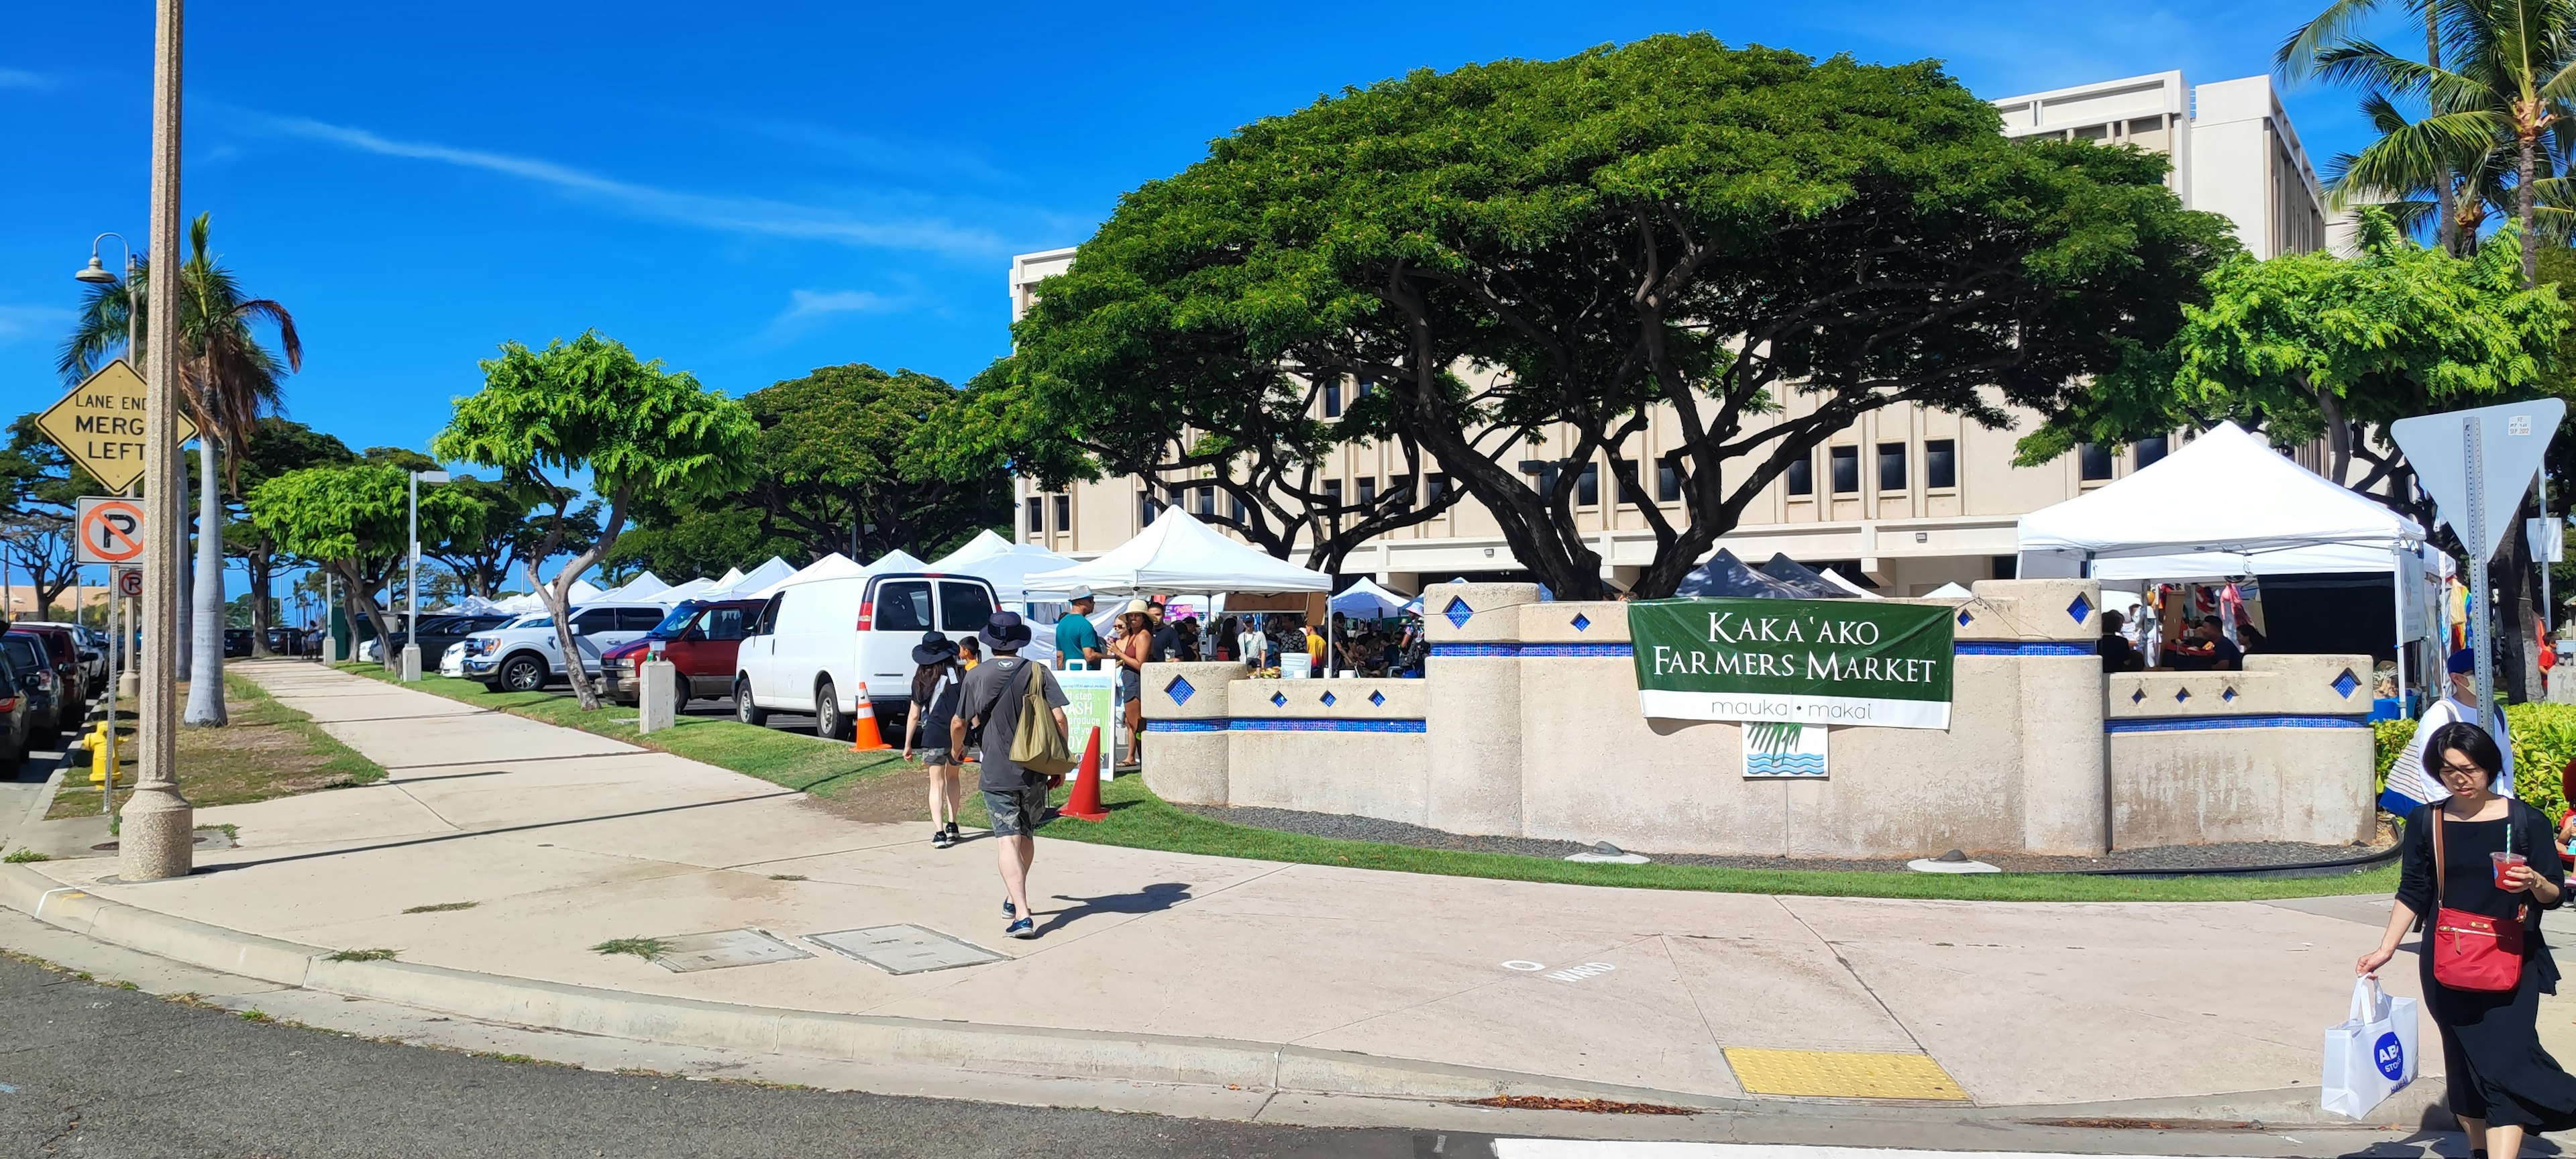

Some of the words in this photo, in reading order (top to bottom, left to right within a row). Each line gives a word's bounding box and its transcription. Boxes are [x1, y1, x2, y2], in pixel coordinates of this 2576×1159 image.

[76, 394, 114, 408] LANE
[122, 396, 147, 410] END
[76, 415, 145, 436] MERG
[88, 441, 146, 461] LEFT
[1652, 645, 1794, 677] FARMERS
[1805, 650, 1937, 683] MARKET
[1065, 701, 1093, 716] ASH
[1712, 699, 1787, 716] mauka
[1809, 702, 1872, 720] makai
[1081, 726, 1092, 736] yo
[1545, 962, 1616, 982] WARD
[2379, 1040, 2399, 1064] AB
